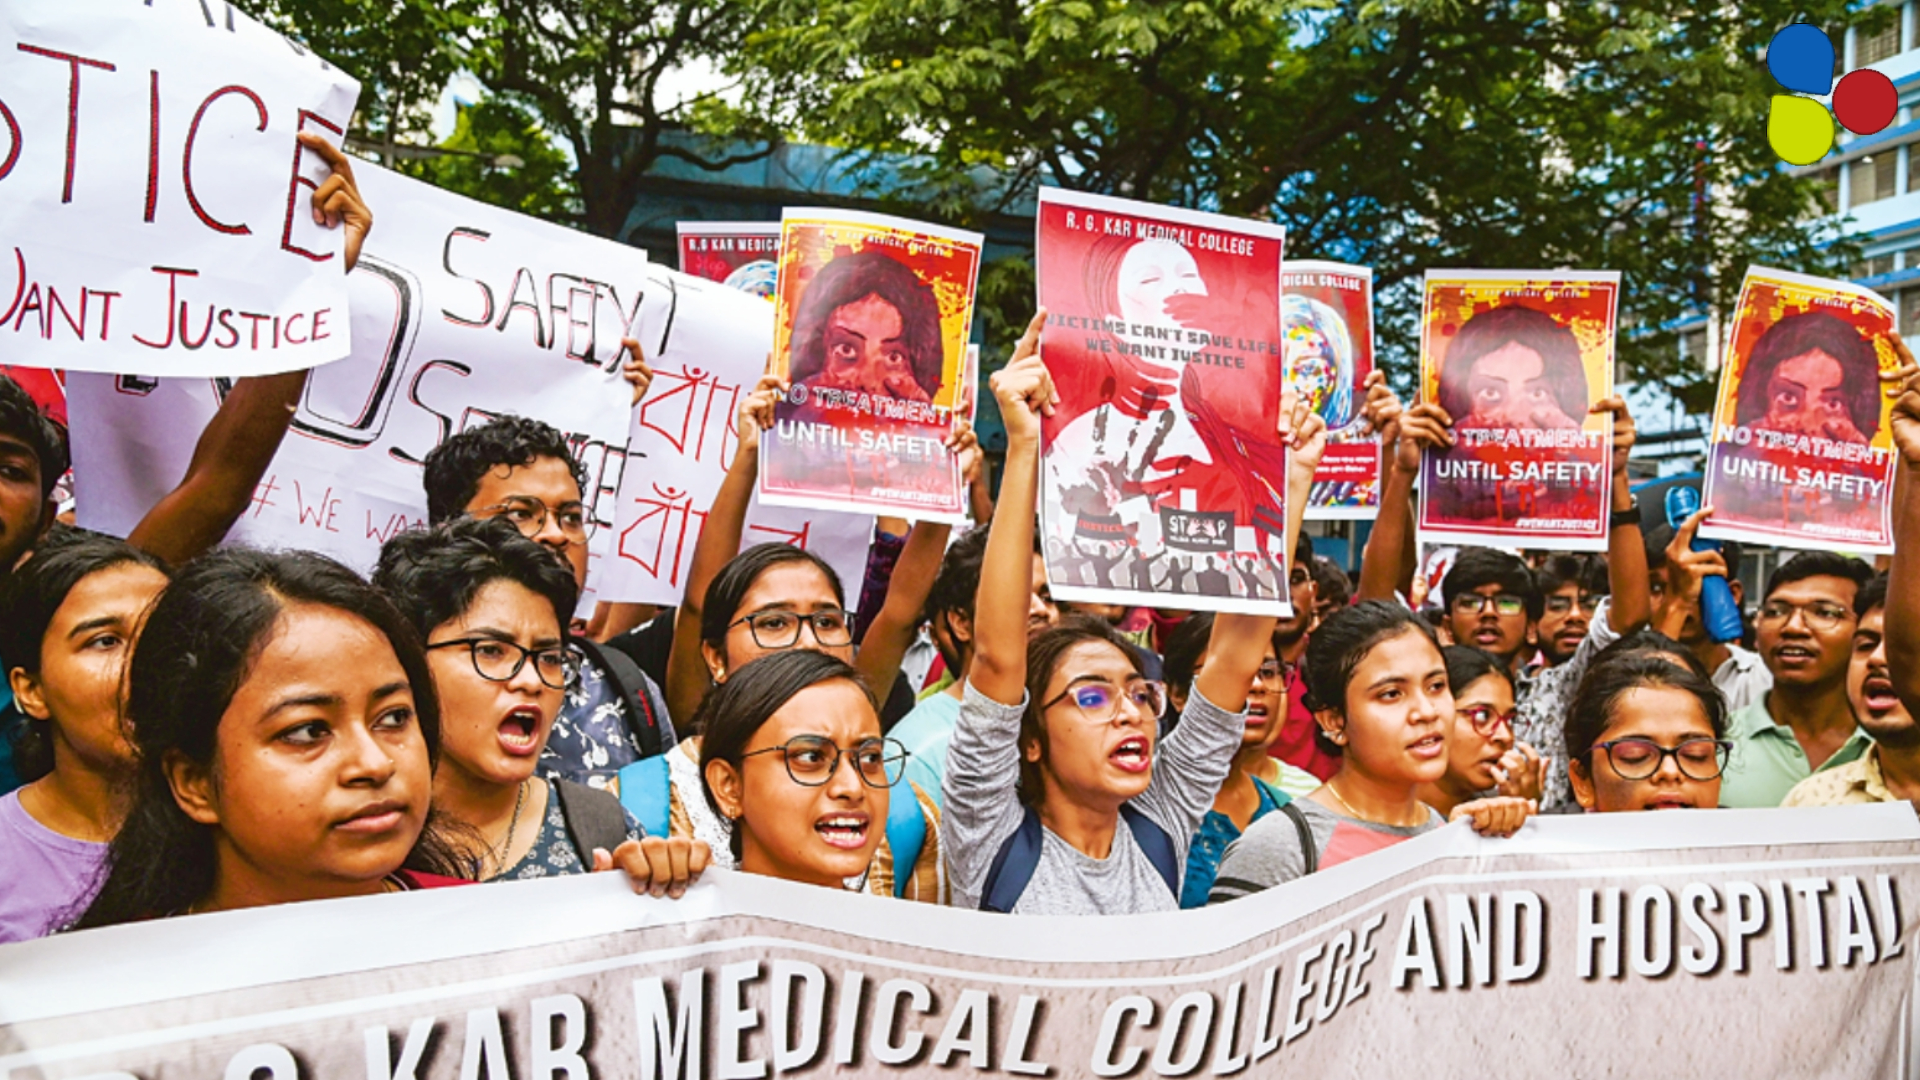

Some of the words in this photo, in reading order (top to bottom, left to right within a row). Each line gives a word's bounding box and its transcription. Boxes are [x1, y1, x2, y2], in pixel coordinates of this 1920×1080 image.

[1104, 217, 1131, 237] KAR
[1136, 222, 1194, 248] MEDICAL
[1199, 232, 1255, 257] COLLEGE
[132, 265, 331, 350] JUSTICE
[441, 226, 643, 374] SAFETY
[1086, 338, 1109, 352] WE
[1116, 341, 1166, 361] WANT
[1171, 348, 1246, 370] JUSTICE
[1131, 322, 1183, 342] CAN'T
[1187, 331, 1233, 349] SAVE
[813, 386, 951, 426] TREATMENT
[778, 418, 854, 448] UNTIL
[859, 430, 948, 458] SAFETY
[1462, 427, 1603, 450] TREATMENT
[1717, 424, 1752, 446] NO
[1755, 428, 1888, 466] TREATMENT
[1435, 459, 1504, 480] UNTIL
[1508, 461, 1601, 482] SAFETY
[1722, 456, 1792, 484] UNTIL
[1797, 467, 1885, 497] SAFETY
[294, 479, 342, 532] WE
[365, 509, 424, 544] WA
[632, 958, 1052, 1080] MEDICAL
[1091, 912, 1386, 1077] COLLEGE
[1390, 889, 1545, 989] AND
[1577, 873, 1905, 979] HOSPITAL
